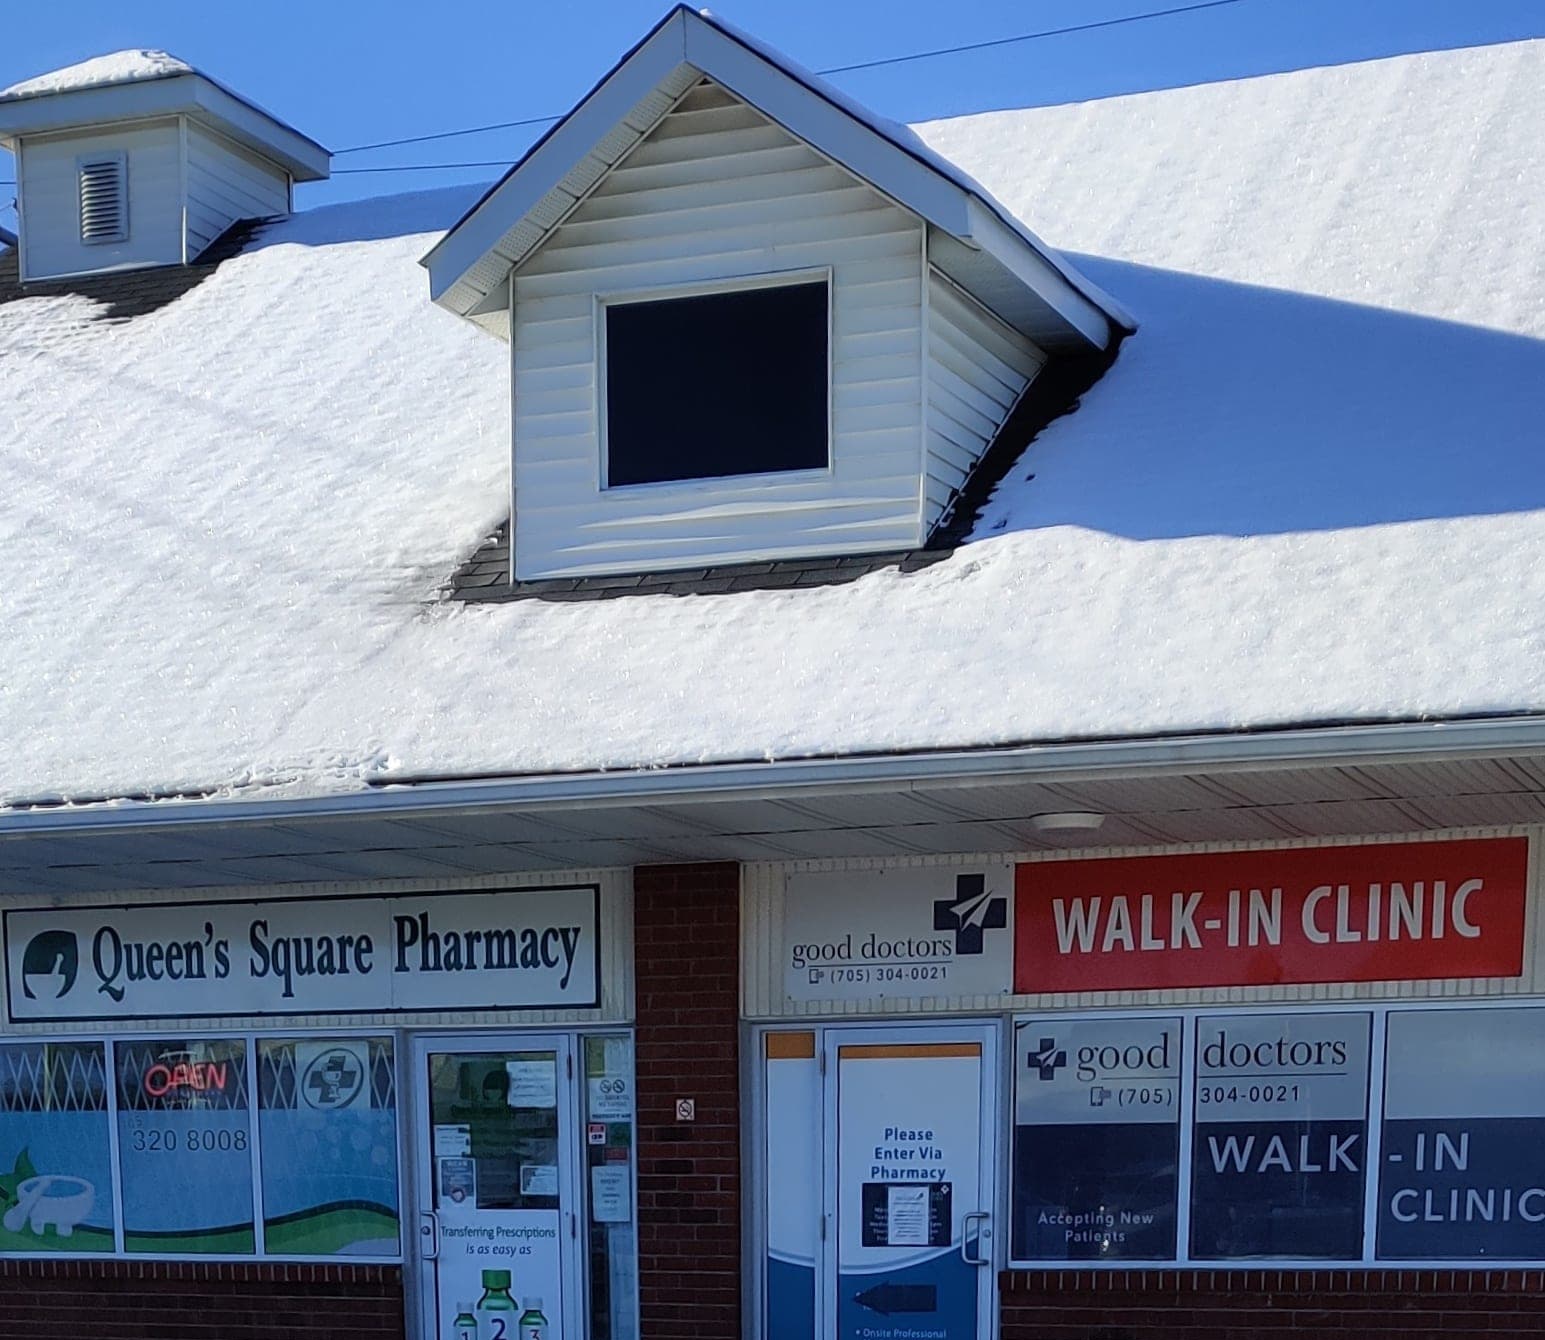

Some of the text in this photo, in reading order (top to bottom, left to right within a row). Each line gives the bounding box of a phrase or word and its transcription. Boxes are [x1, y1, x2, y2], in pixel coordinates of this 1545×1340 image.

[1052, 878, 1483, 955] WALK-IN CLINIC
[92, 911, 581, 1002] Queen's Square Pharmacy
[791, 933, 953, 970] good doctors
[830, 966, 947, 984] (705) 304-0021
[1076, 1030, 1347, 1082] good doctors
[144, 1062, 227, 1096] OPEN
[1117, 1085, 1299, 1107] (705) 304-0021
[133, 1129, 247, 1151] 320 8008
[884, 1127, 934, 1141] Please
[874, 1146, 943, 1160] Enter Via
[1207, 1133, 1360, 1174] WALK
[871, 1165, 946, 1181] Pharmacy
[1391, 1188, 1545, 1222] CLINIC
[1038, 1211, 1154, 1227] Accepting New
[441, 1225, 556, 1240] Transferring Prescriptions
[1065, 1229, 1126, 1243] Patients
[466, 1243, 532, 1258] is as easy as
[862, 1328, 947, 1340] Onsite Professional
